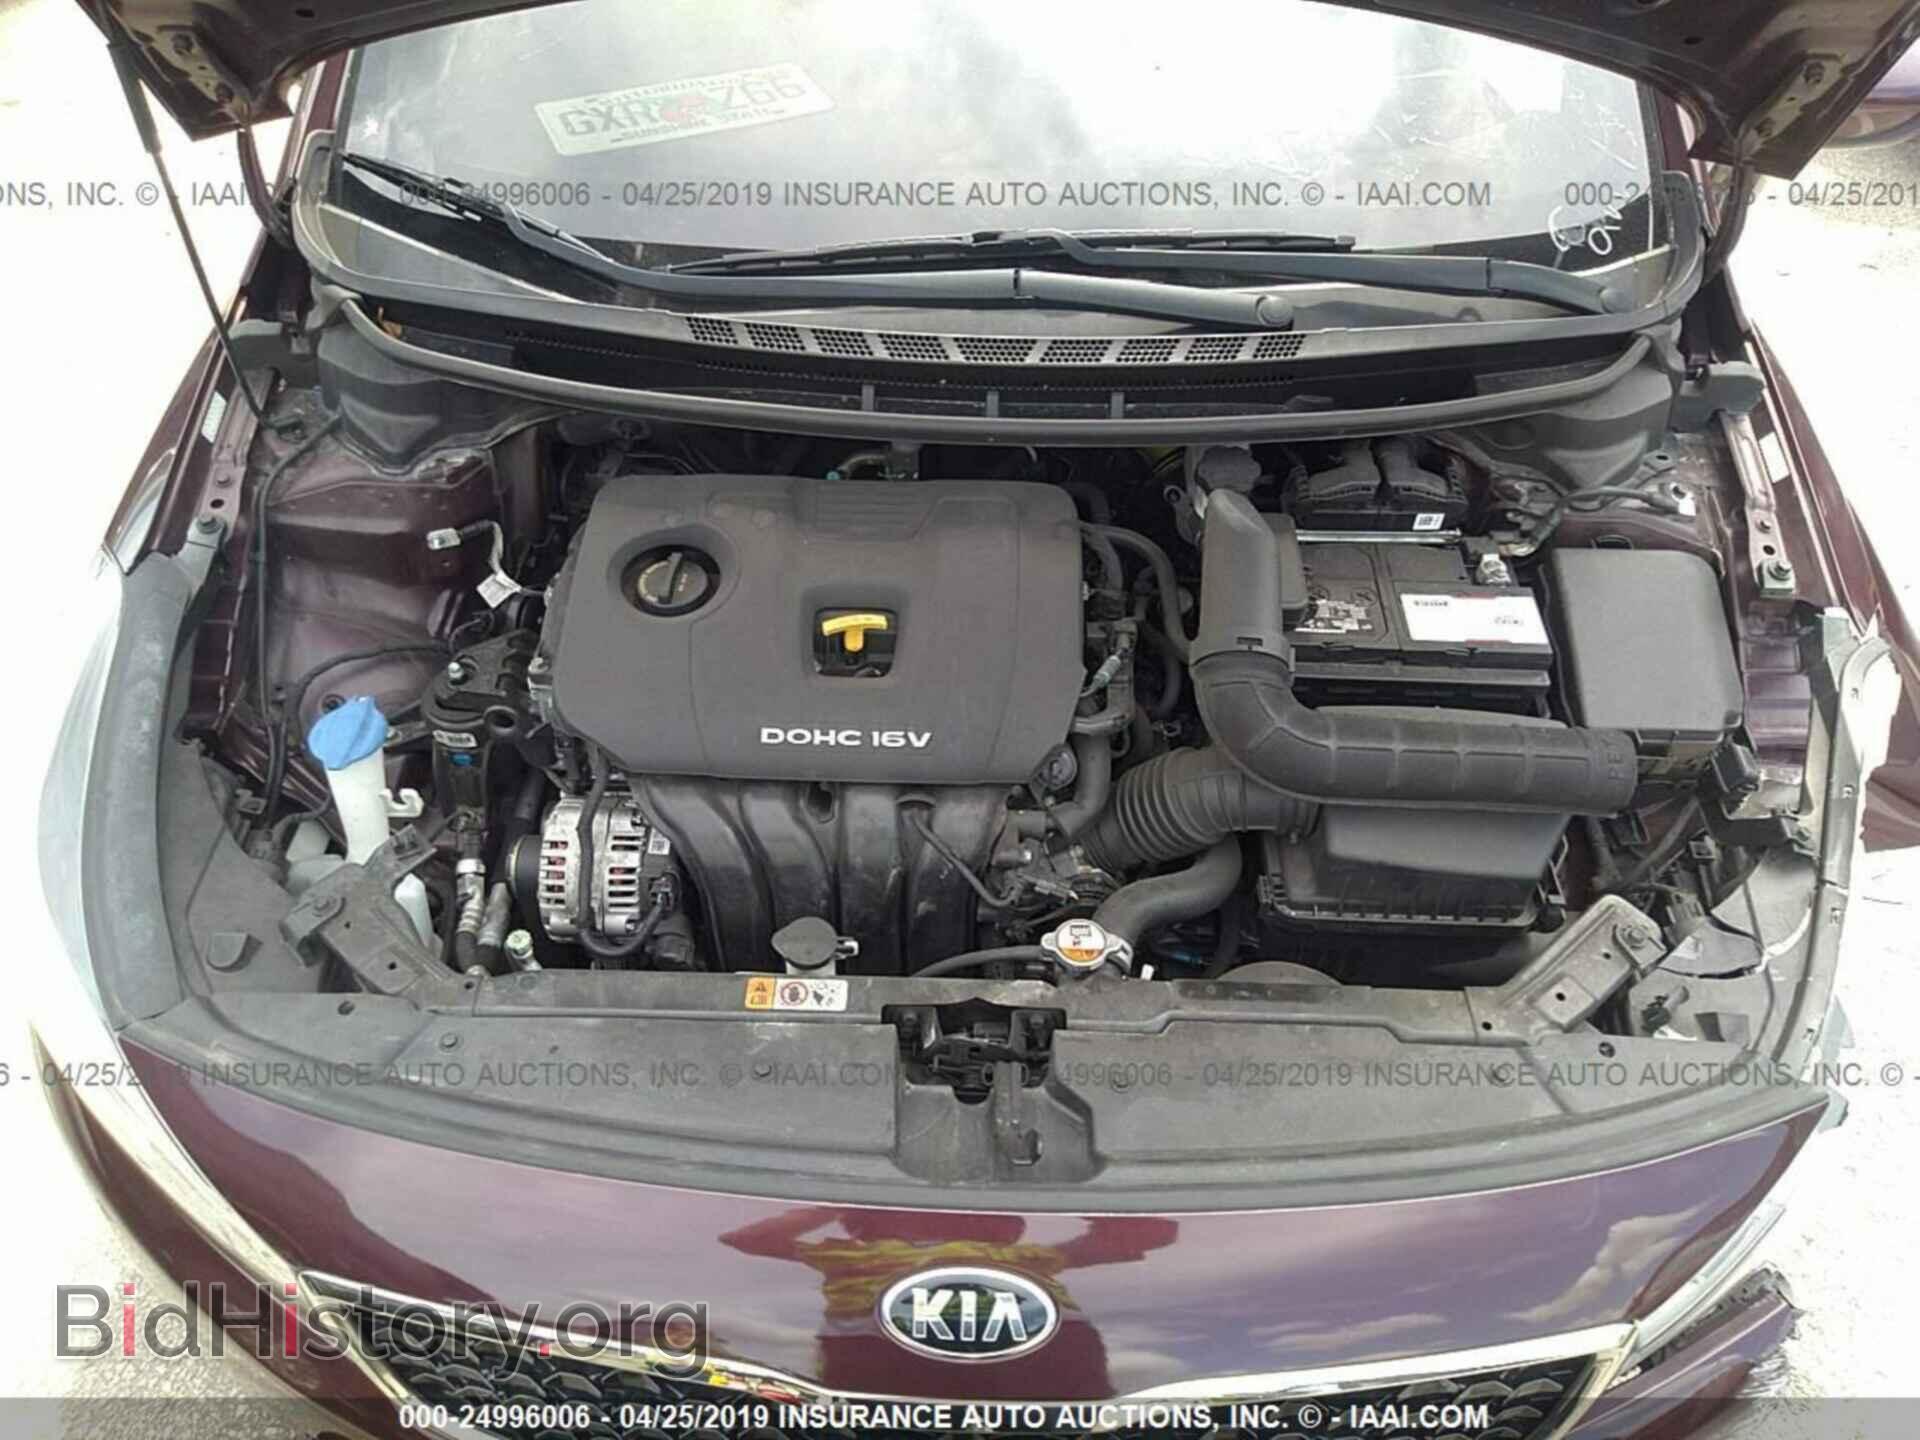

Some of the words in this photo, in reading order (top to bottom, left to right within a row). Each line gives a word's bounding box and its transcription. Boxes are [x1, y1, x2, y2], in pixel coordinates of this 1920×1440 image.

[760, 727, 862, 746] DOHC
[872, 731, 932, 748] 16V
[912, 1287, 1028, 1342] KIA
